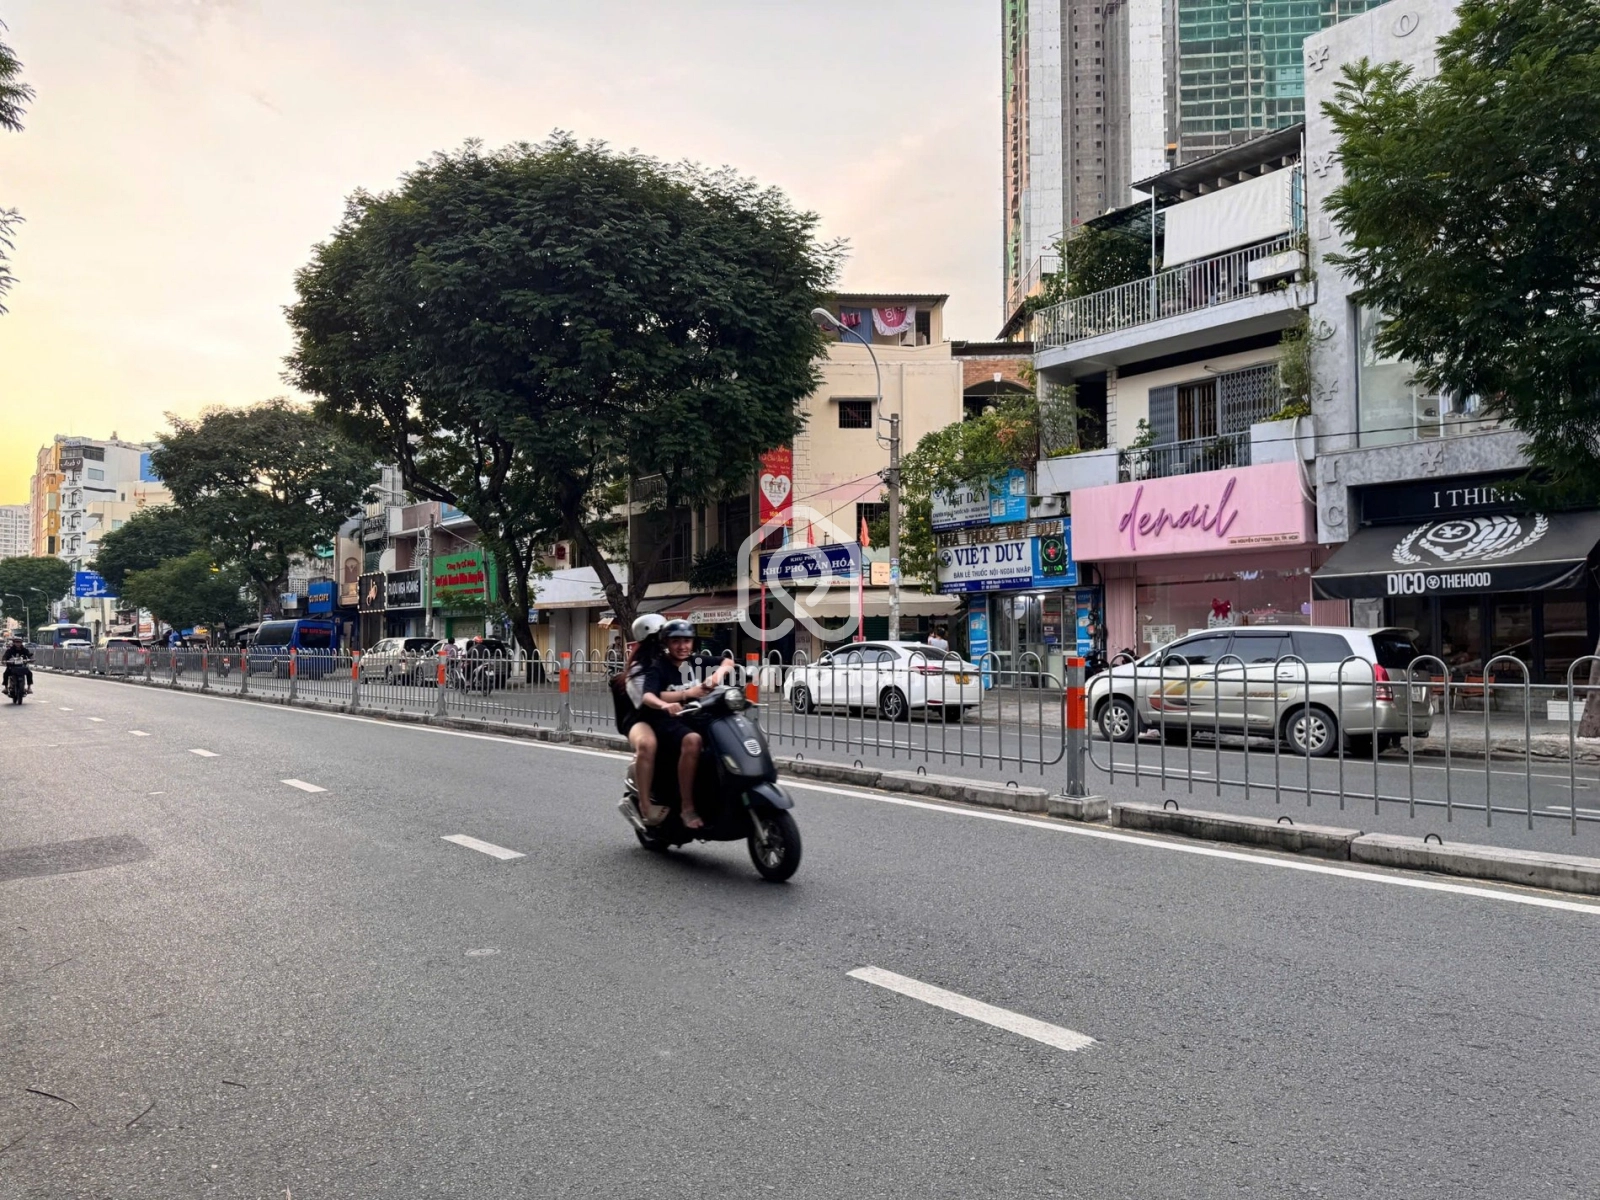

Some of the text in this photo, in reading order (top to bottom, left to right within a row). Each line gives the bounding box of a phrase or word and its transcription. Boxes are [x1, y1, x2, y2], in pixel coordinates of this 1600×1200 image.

[1433, 491, 1440, 508] I
[1119, 476, 1238, 551] denail
[763, 566, 782, 576] KHU
[785, 561, 804, 573] PHỐ
[807, 560, 829, 571] VĂN
[832, 557, 856, 568] HÓA
[954, 542, 1025, 568] VIỆT DUY
[1387, 572, 1491, 595] DICO THEHOOD
